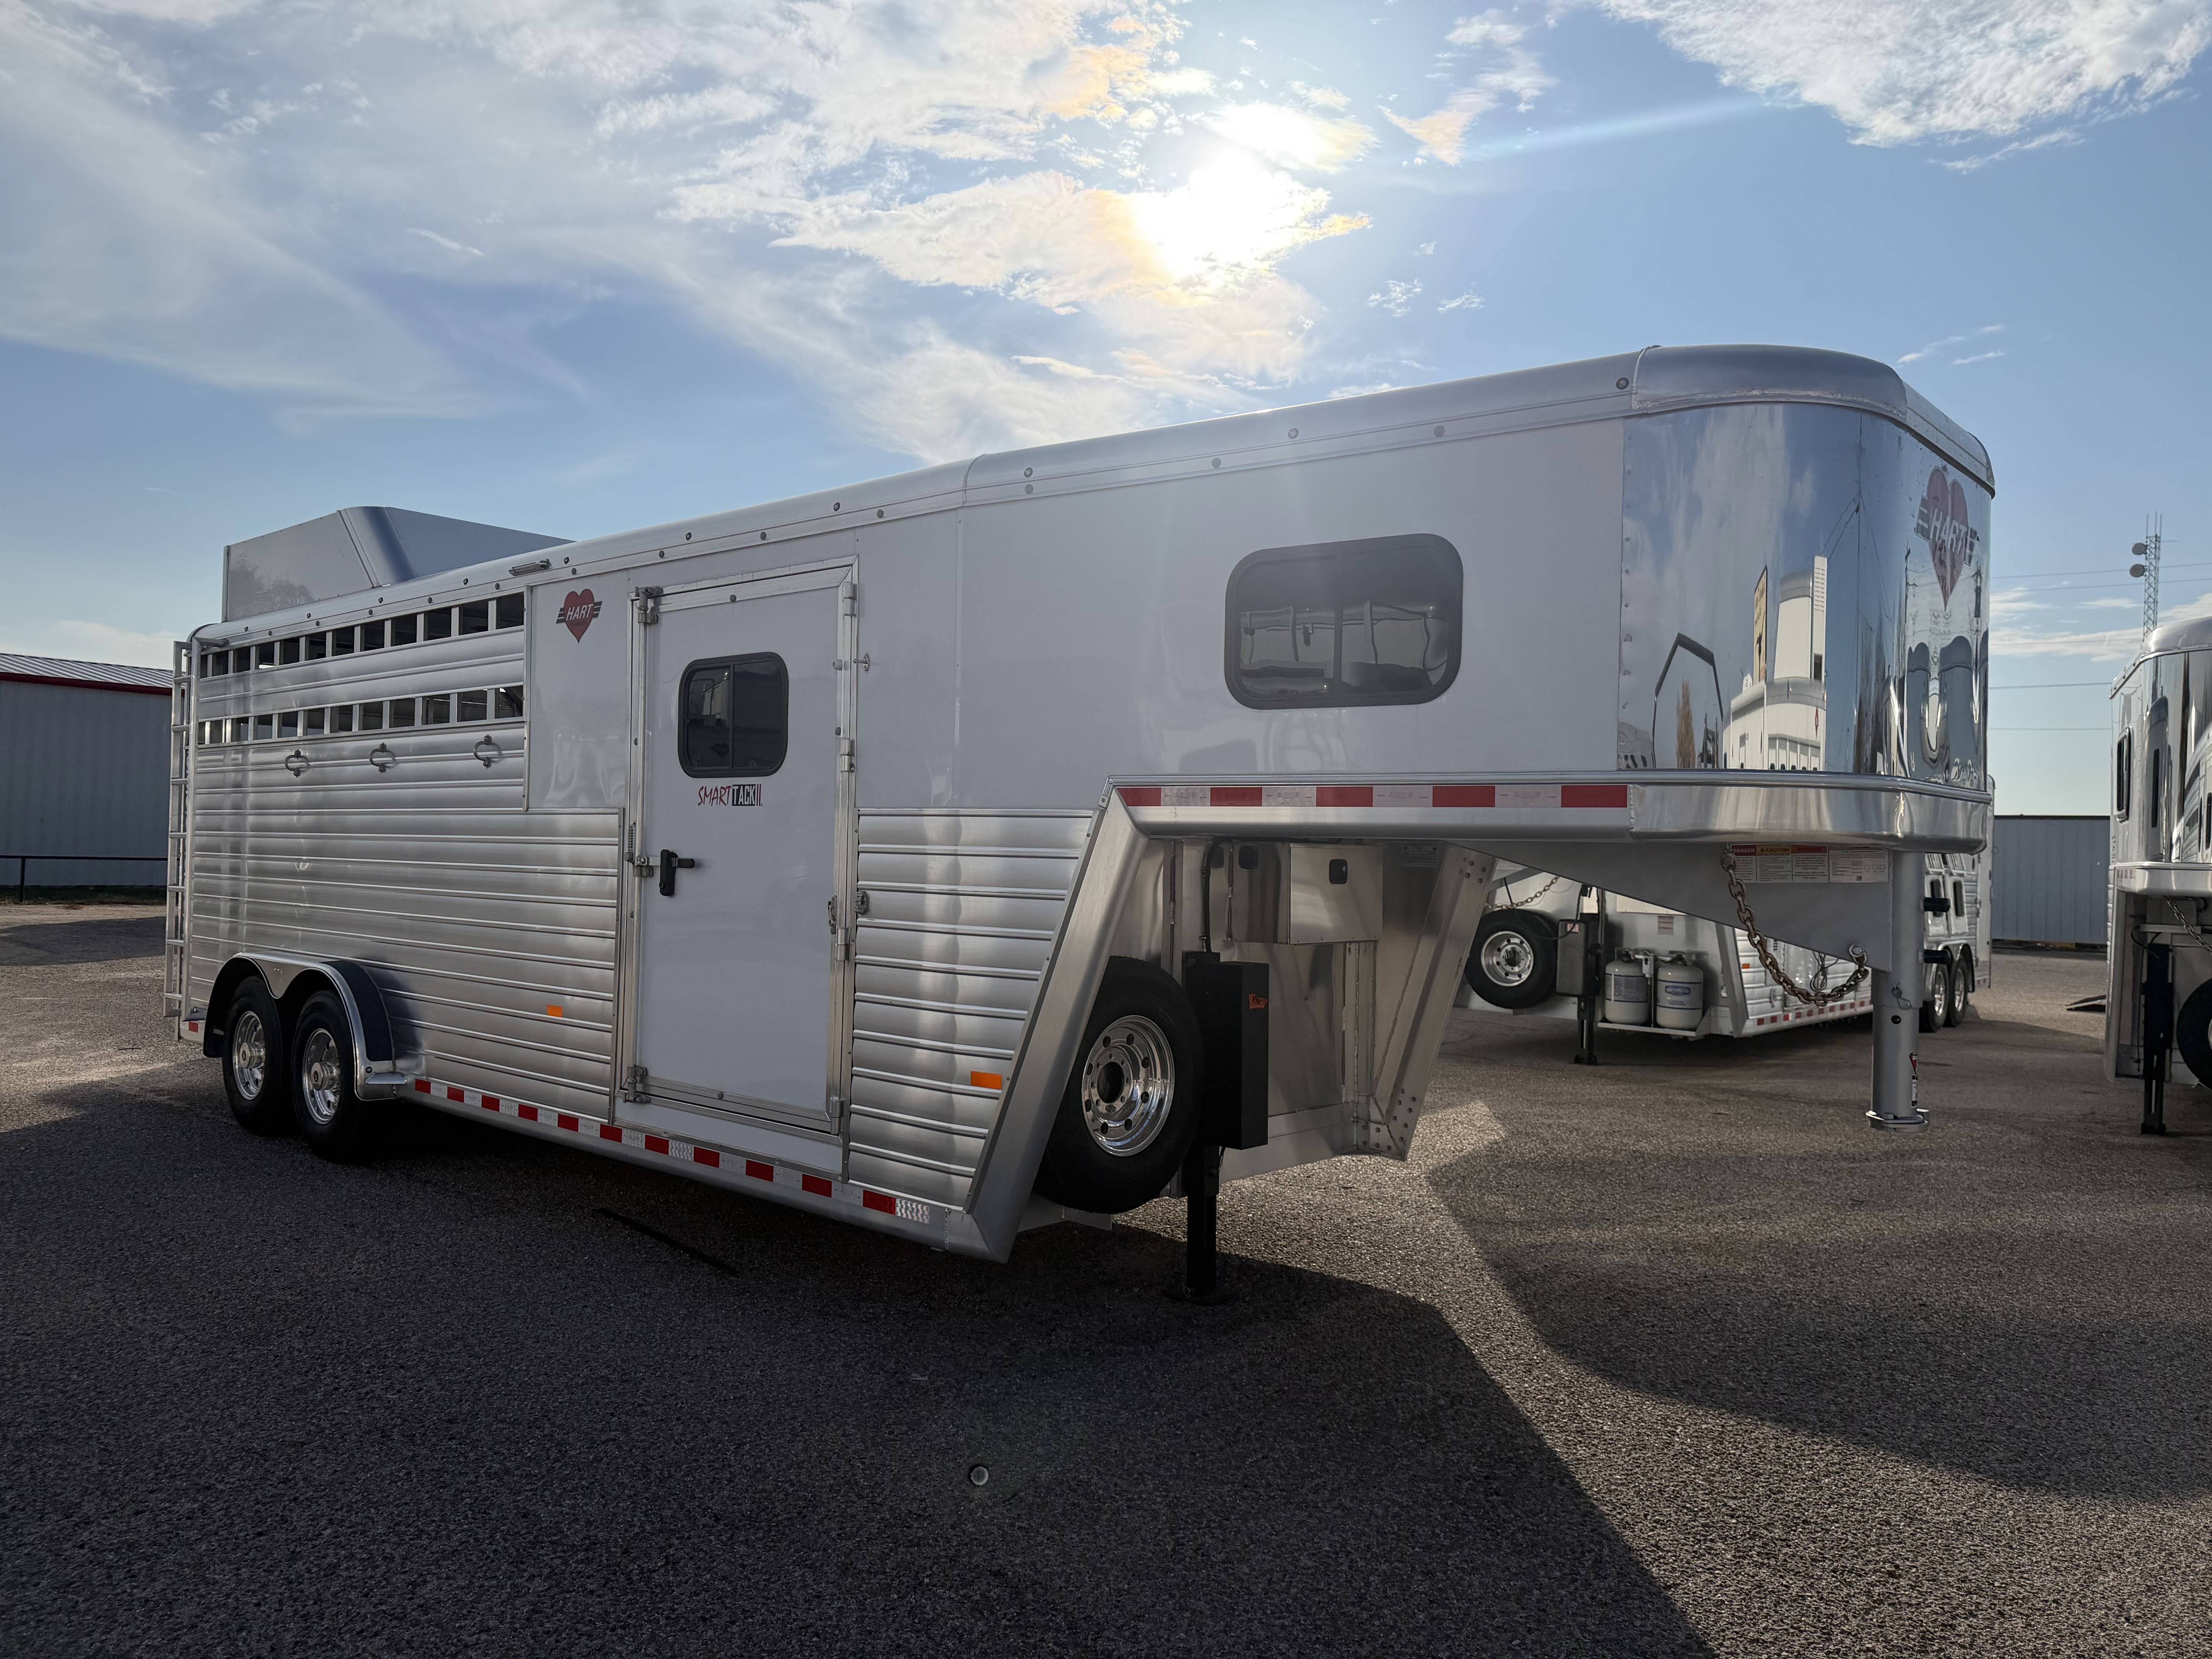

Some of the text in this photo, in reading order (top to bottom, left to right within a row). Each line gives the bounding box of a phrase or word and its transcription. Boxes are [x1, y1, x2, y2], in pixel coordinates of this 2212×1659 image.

[1930, 507, 1968, 555] HART
[566, 603, 594, 621] HART
[698, 785, 732, 807] SMART
[733, 785, 755, 805] TACK
